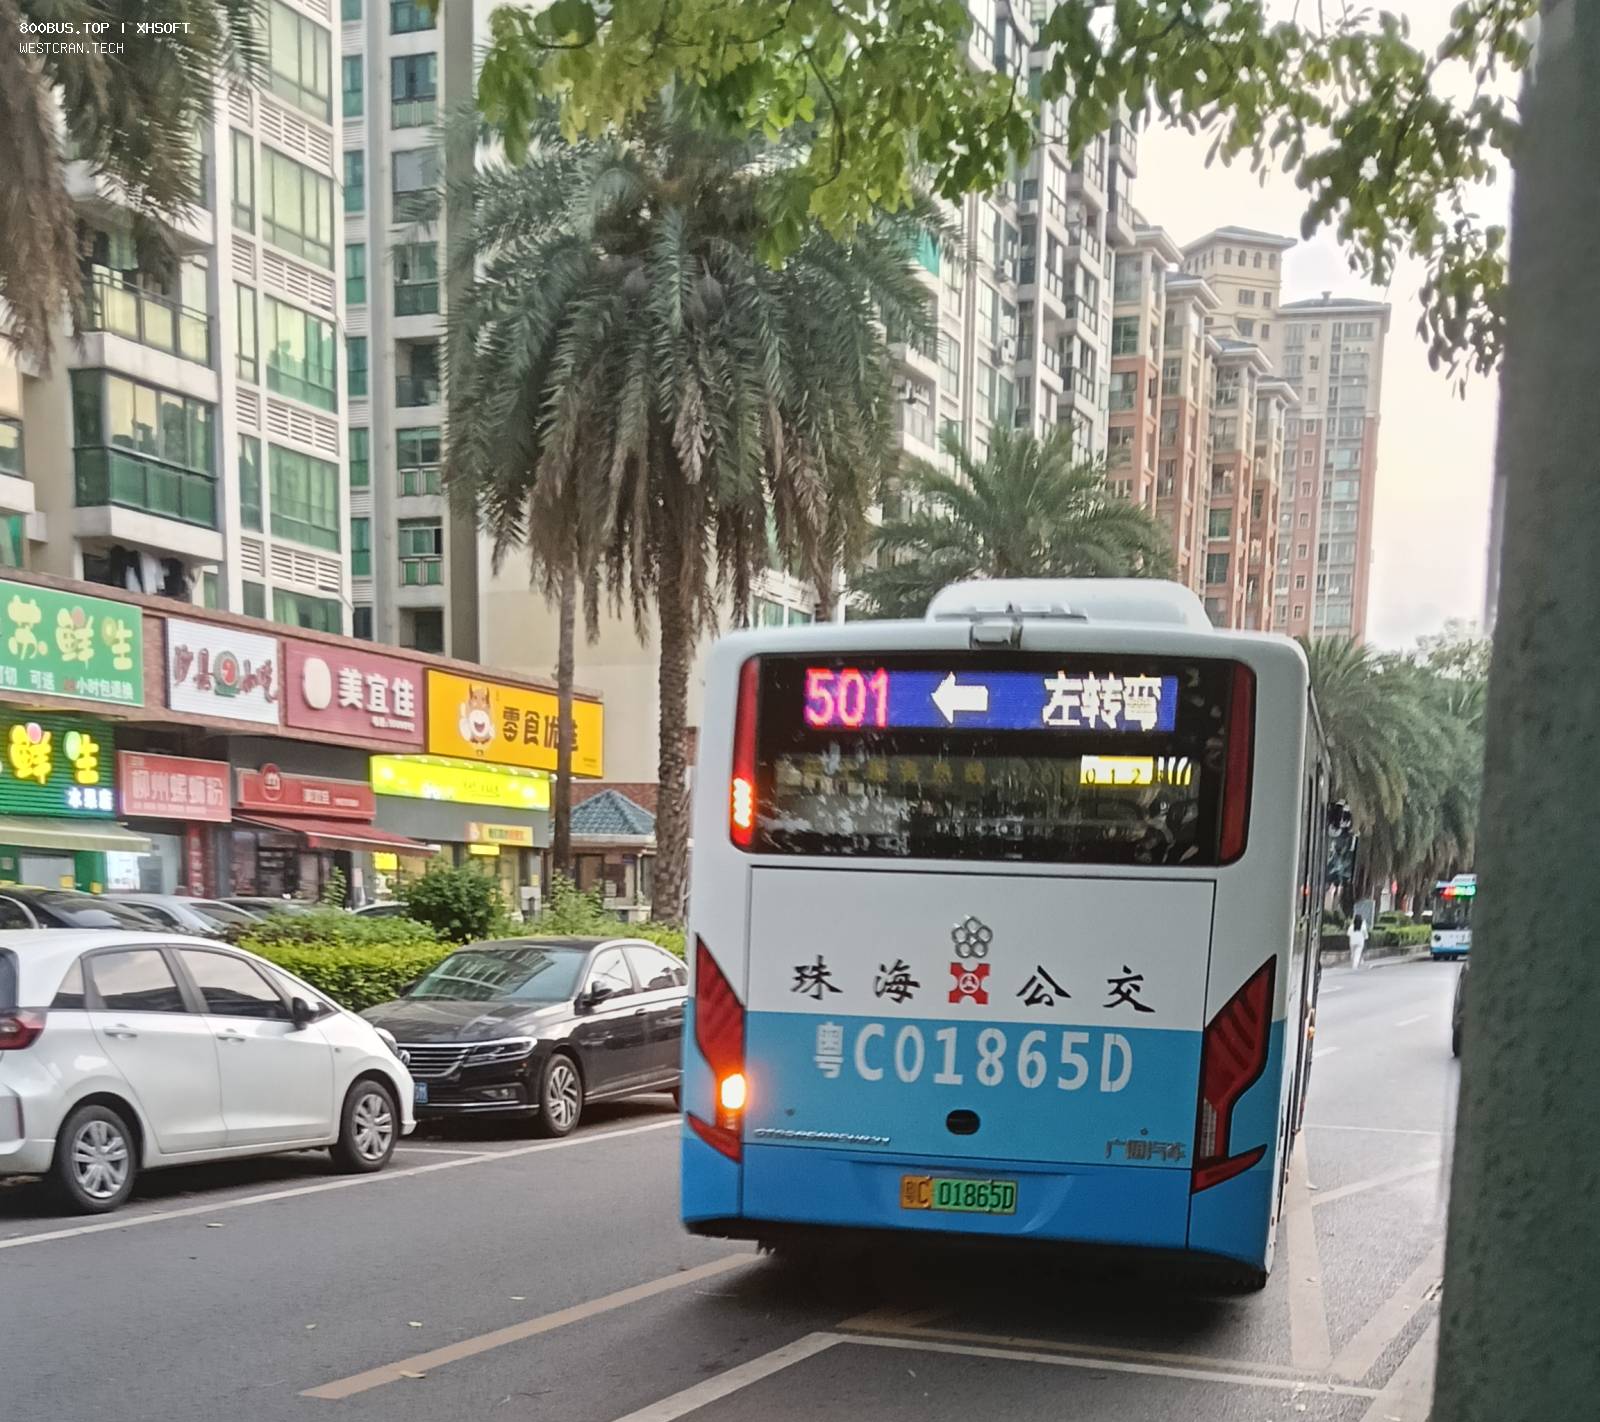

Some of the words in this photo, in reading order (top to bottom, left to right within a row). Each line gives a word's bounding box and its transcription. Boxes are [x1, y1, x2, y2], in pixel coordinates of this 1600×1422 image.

[339, 667, 415, 717] 美宜佳
[805, 667, 890, 730] 501
[1042, 670, 1161, 732] 左转弯
[0, 722, 100, 785] 鲜生
[790, 954, 1156, 1013] 珠海公交
[813, 1021, 1134, 1093] 粤C01865D
